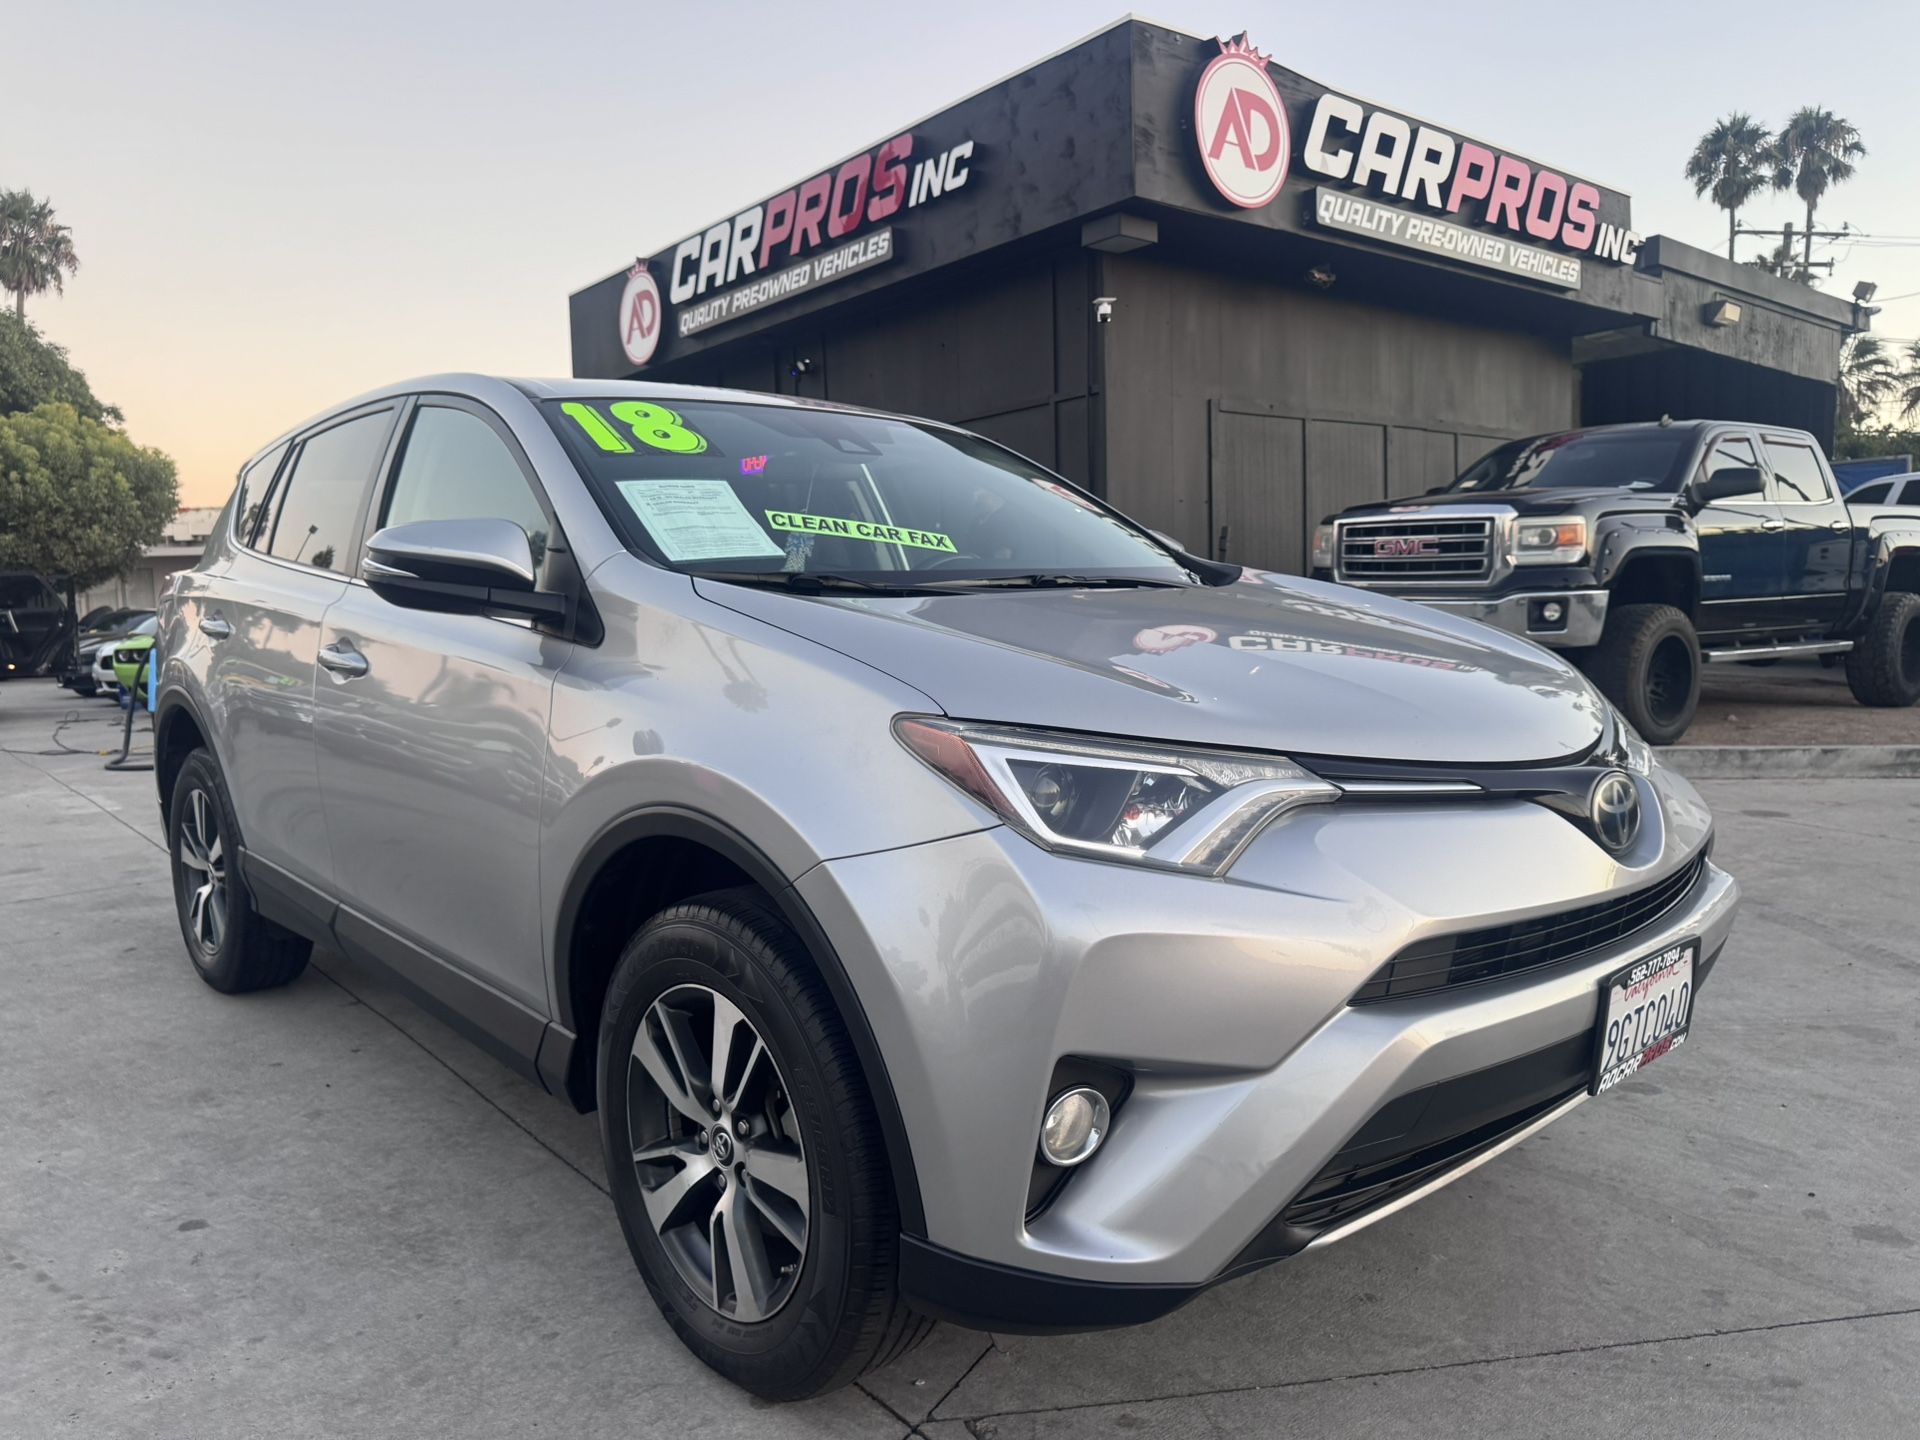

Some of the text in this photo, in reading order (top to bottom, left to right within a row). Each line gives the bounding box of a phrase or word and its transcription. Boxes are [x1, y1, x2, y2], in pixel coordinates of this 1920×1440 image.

[1208, 87, 1280, 172] AD
[908, 140, 974, 208] INC
[1318, 194, 1580, 284] QUALITY PRE-OWNED VEHICLES
[1594, 222, 1640, 265] INC
[680, 295, 732, 336] QUALITY
[814, 231, 891, 281] VEHICLES
[560, 401, 708, 454] 18
[771, 513, 951, 549] CLEAN CAR FAX
[1375, 536, 1439, 557] GMC
[1600, 981, 1689, 1075] 9GTC040
